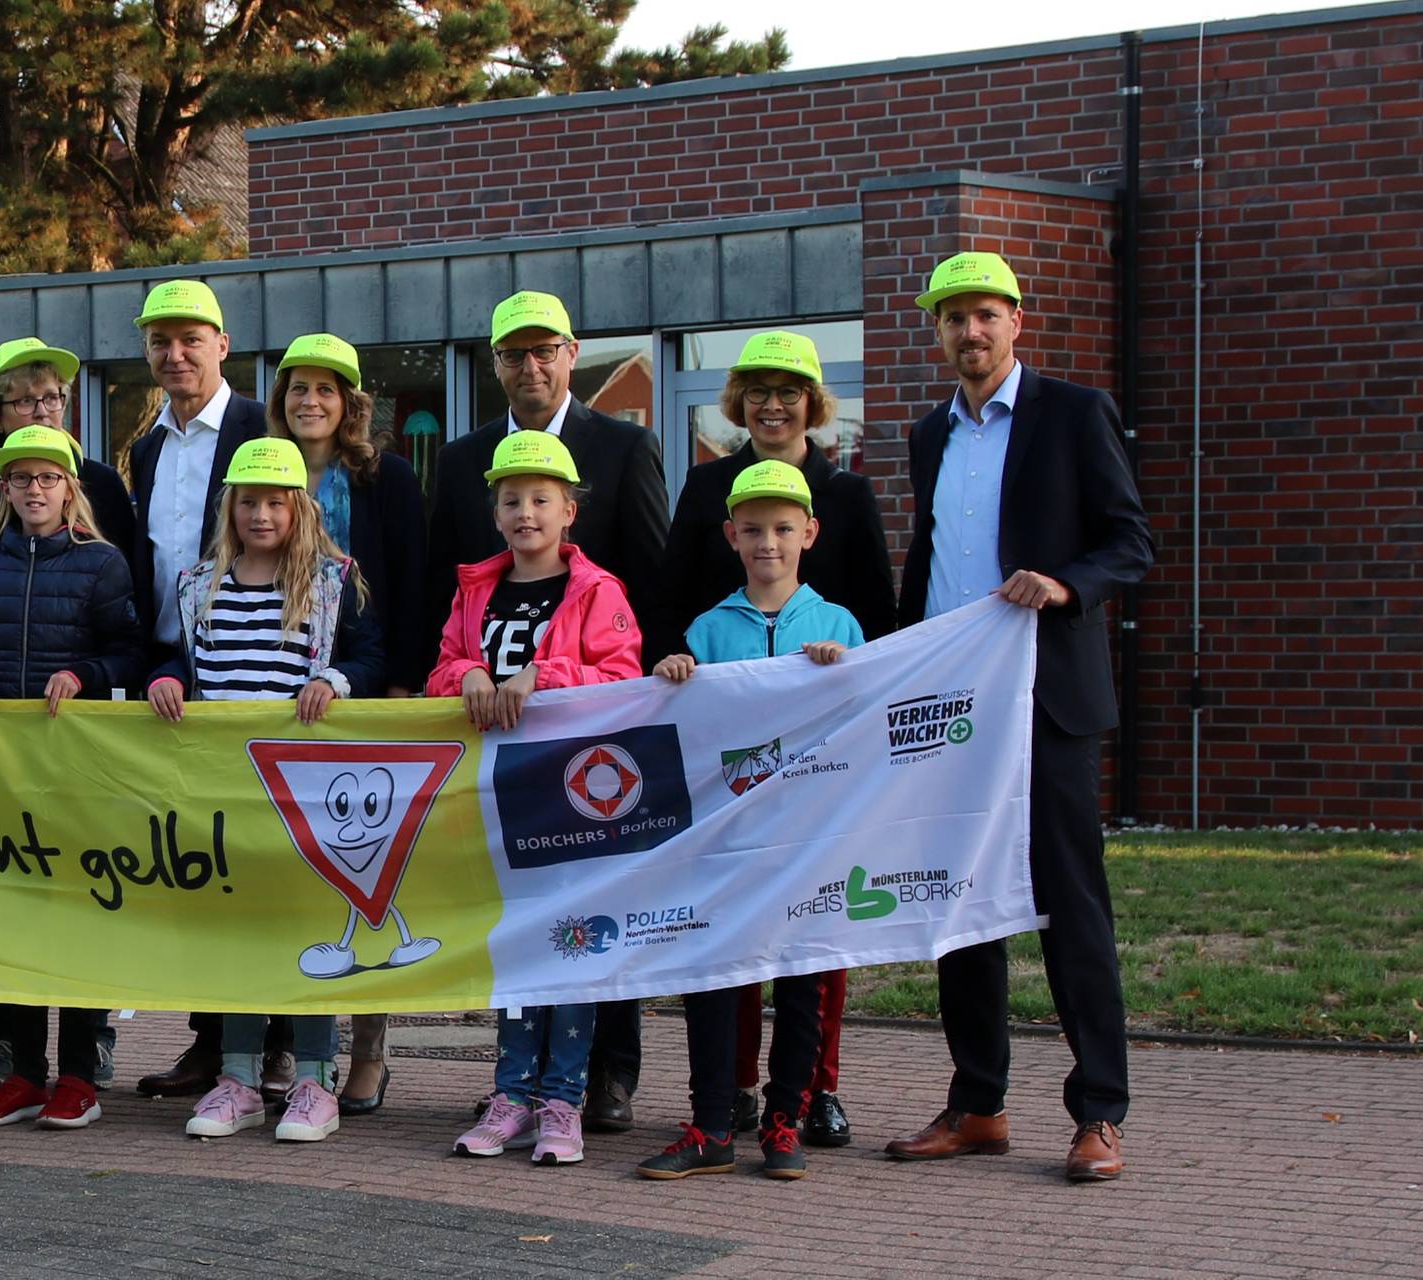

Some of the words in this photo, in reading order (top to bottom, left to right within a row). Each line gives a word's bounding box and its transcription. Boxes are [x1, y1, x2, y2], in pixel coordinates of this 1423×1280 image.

[887, 697, 974, 728] VERKEHRS
[888, 722, 948, 747] WACHT
[782, 769, 809, 779] Kreis
[811, 761, 849, 774] Borken
[890, 756, 910, 765] KREIS
[911, 750, 942, 763] BORKEN
[516, 829, 606, 850] BORCHERS
[620, 816, 676, 835] Borken
[80, 810, 232, 910] gelb!
[818, 880, 846, 895] WEST
[871, 869, 948, 888] MÜNSTERLAND
[626, 906, 694, 928] POLIZEI
[787, 893, 843, 921] KREIS
[624, 939, 643, 947] Kreis
[645, 936, 677, 945] Borken
[625, 921, 710, 938] Nordrhein-Westfalen
